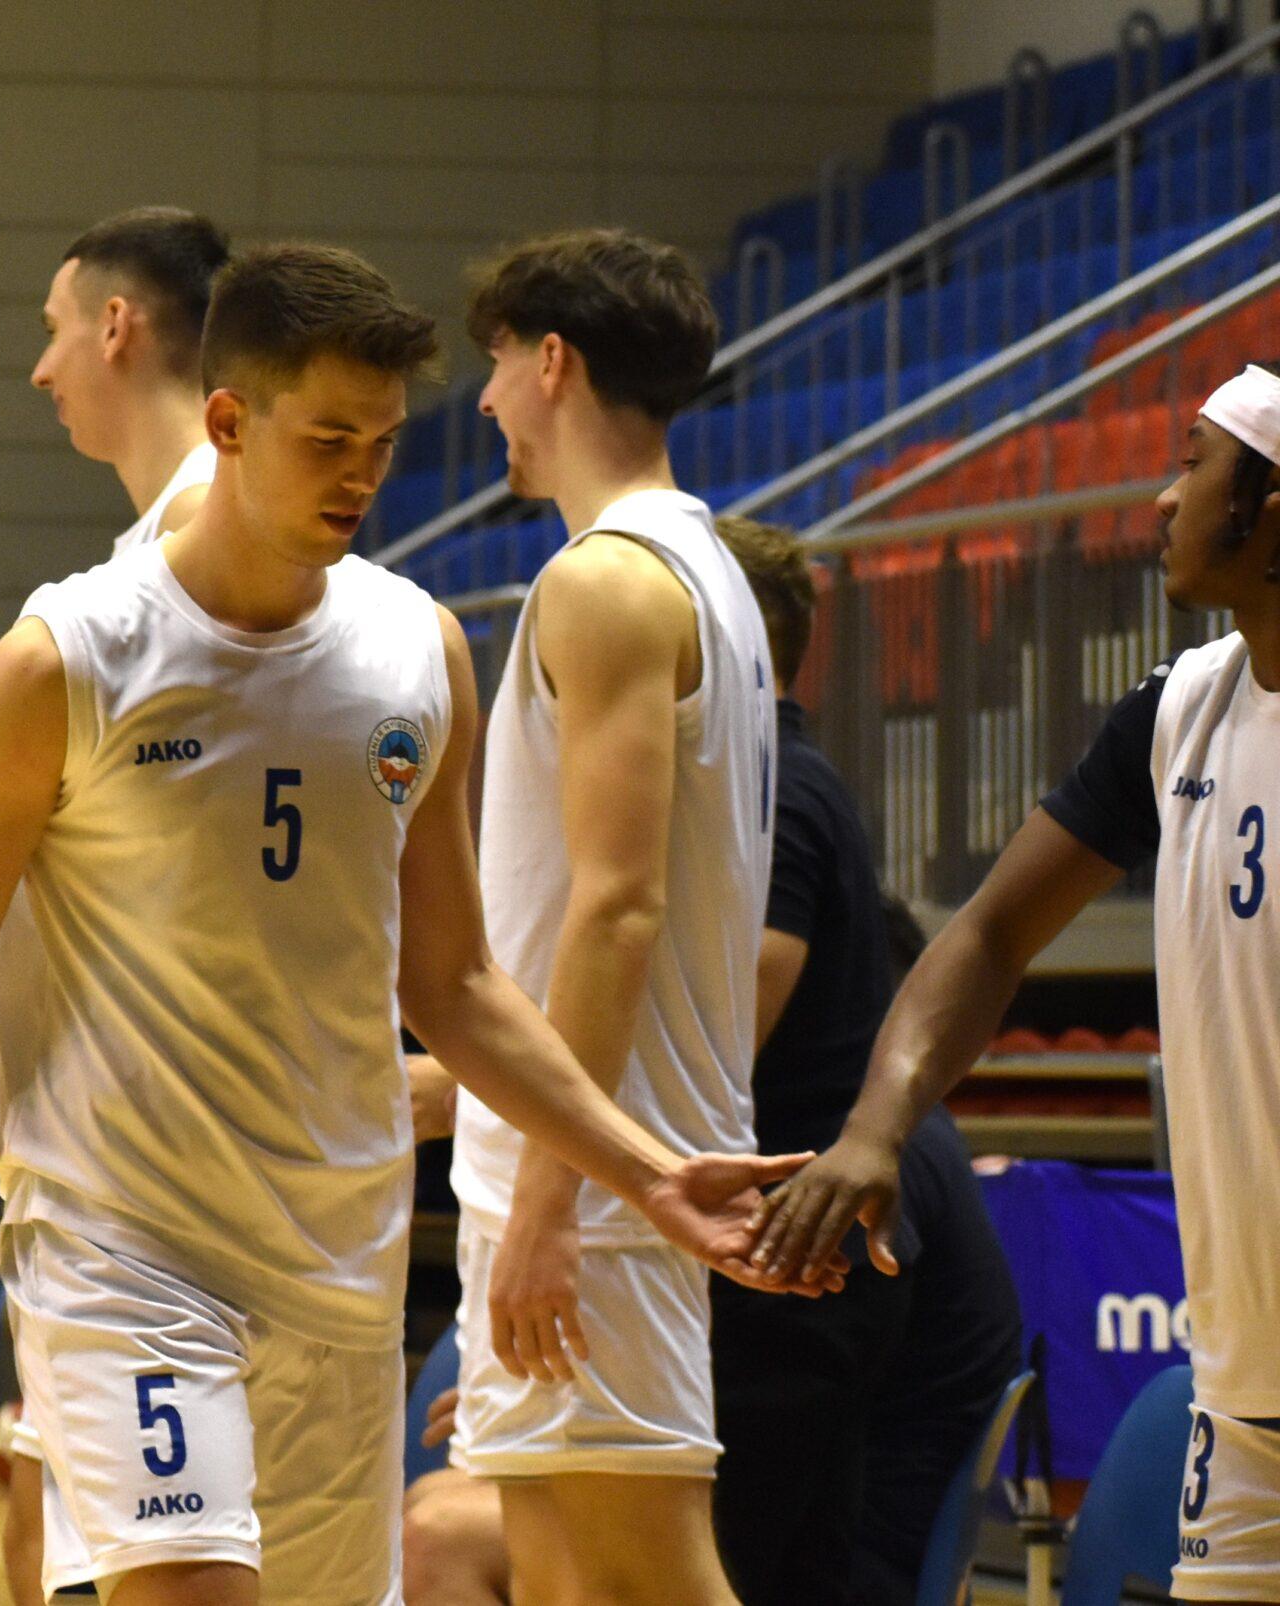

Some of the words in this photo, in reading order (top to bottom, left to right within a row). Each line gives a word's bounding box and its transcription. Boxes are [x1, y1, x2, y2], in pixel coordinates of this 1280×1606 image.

[134, 738, 203, 766] JAKO
[262, 768, 302, 882] 5
[1229, 804, 1265, 919] 3
[135, 1373, 187, 1477] 5
[1183, 1411, 1215, 1521] 3
[135, 1492, 204, 1521] JAKO
